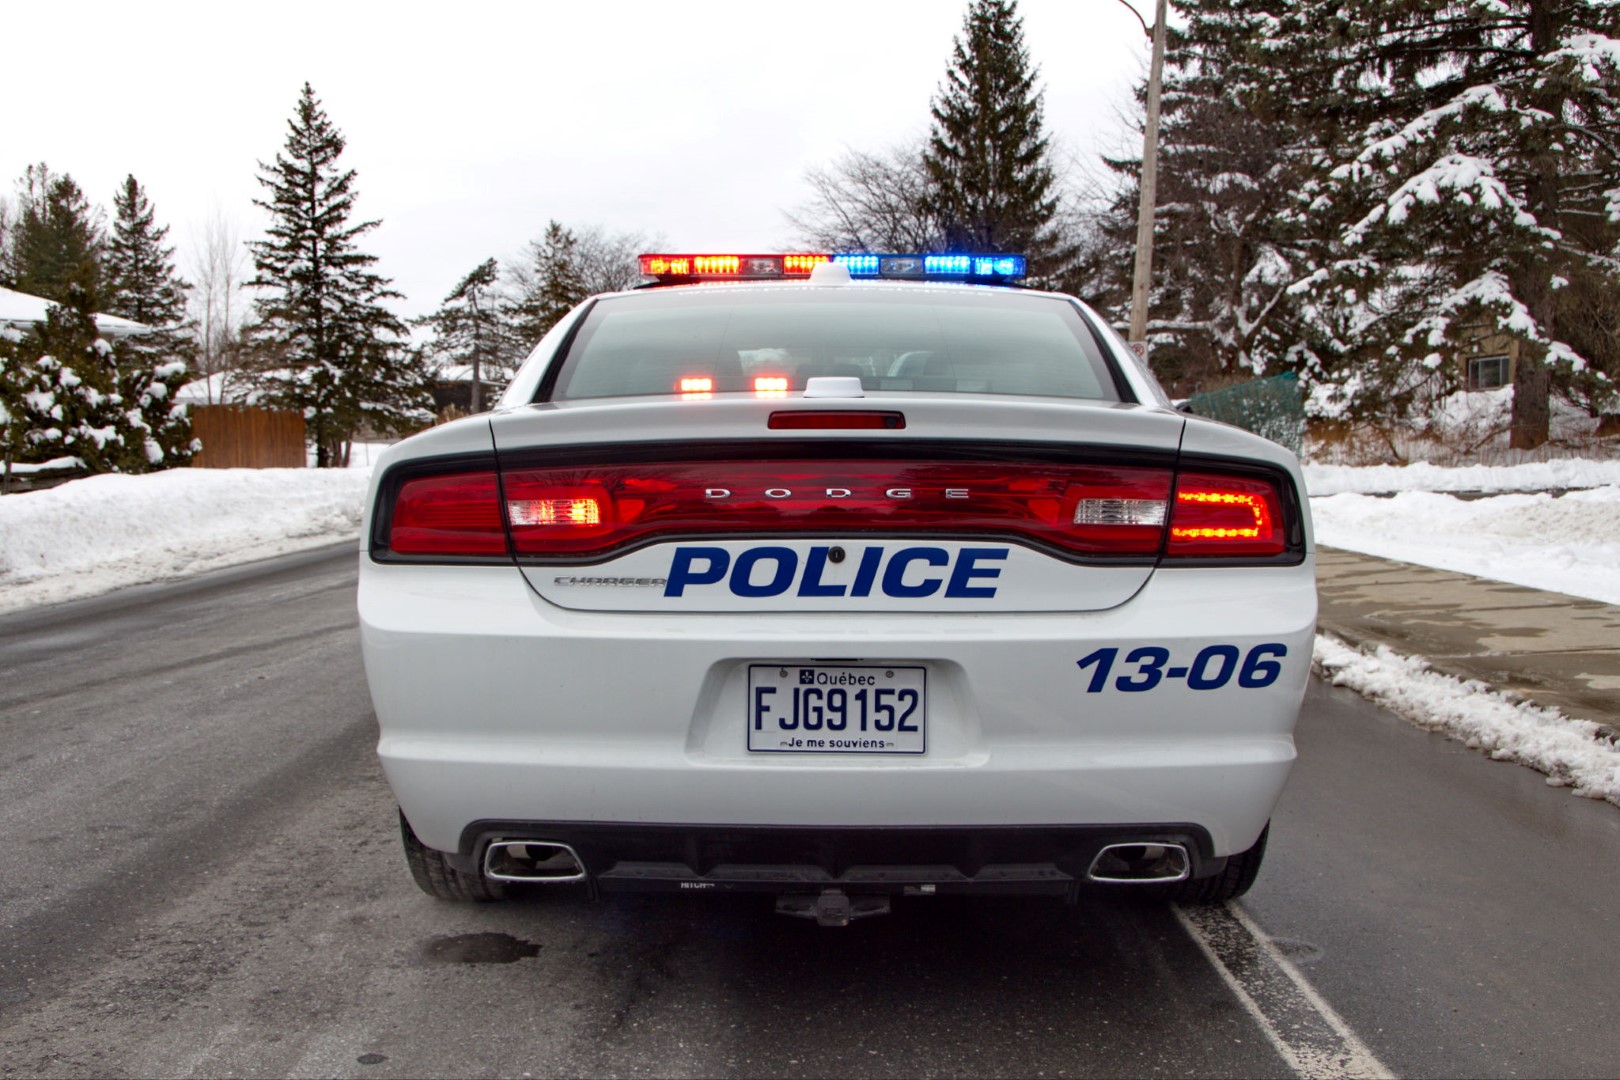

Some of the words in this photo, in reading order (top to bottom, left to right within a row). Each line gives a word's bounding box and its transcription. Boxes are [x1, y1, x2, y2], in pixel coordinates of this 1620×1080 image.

[705, 488, 969, 498] DODGE
[664, 546, 1010, 599] POLICE
[554, 577, 667, 587] CHARGER
[1076, 643, 1288, 693] 13-06
[816, 672, 876, 686] Québec
[754, 686, 919, 732] FJG9152
[788, 737, 803, 748] Je
[806, 740, 825, 748] me
[829, 738, 885, 749] souviens
